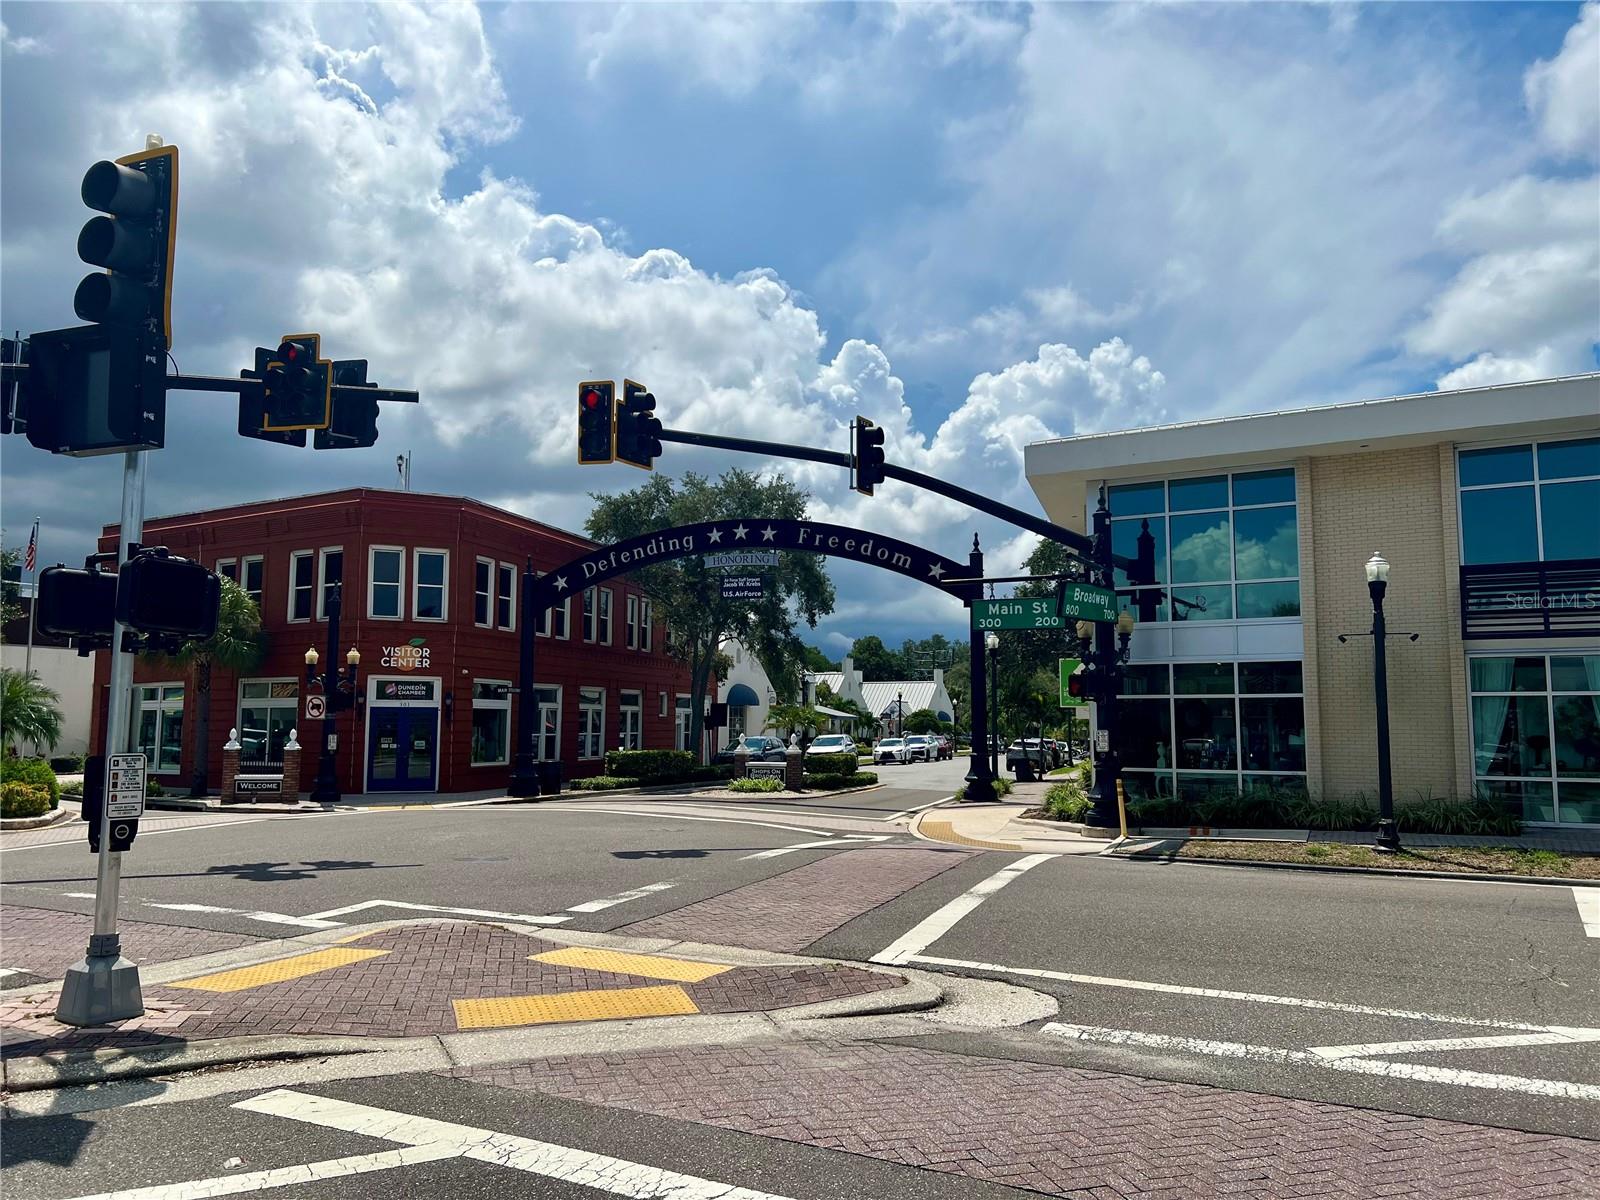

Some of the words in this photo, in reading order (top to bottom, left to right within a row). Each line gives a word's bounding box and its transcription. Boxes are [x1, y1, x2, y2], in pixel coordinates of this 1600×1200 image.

[581, 535, 693, 578] Defending
[797, 528, 912, 569] Freedom
[713, 555, 770, 565] HONORING
[1074, 588, 1109, 608] Broadway
[988, 603, 1023, 615] Main
[1032, 602, 1048, 614] St
[1065, 604, 1080, 616] 800
[1103, 609, 1115, 620] 700
[979, 618, 1002, 628] 300
[1035, 616, 1059, 627] 200
[382, 646, 430, 657] VISITOR
[381, 657, 430, 668] CENTER
